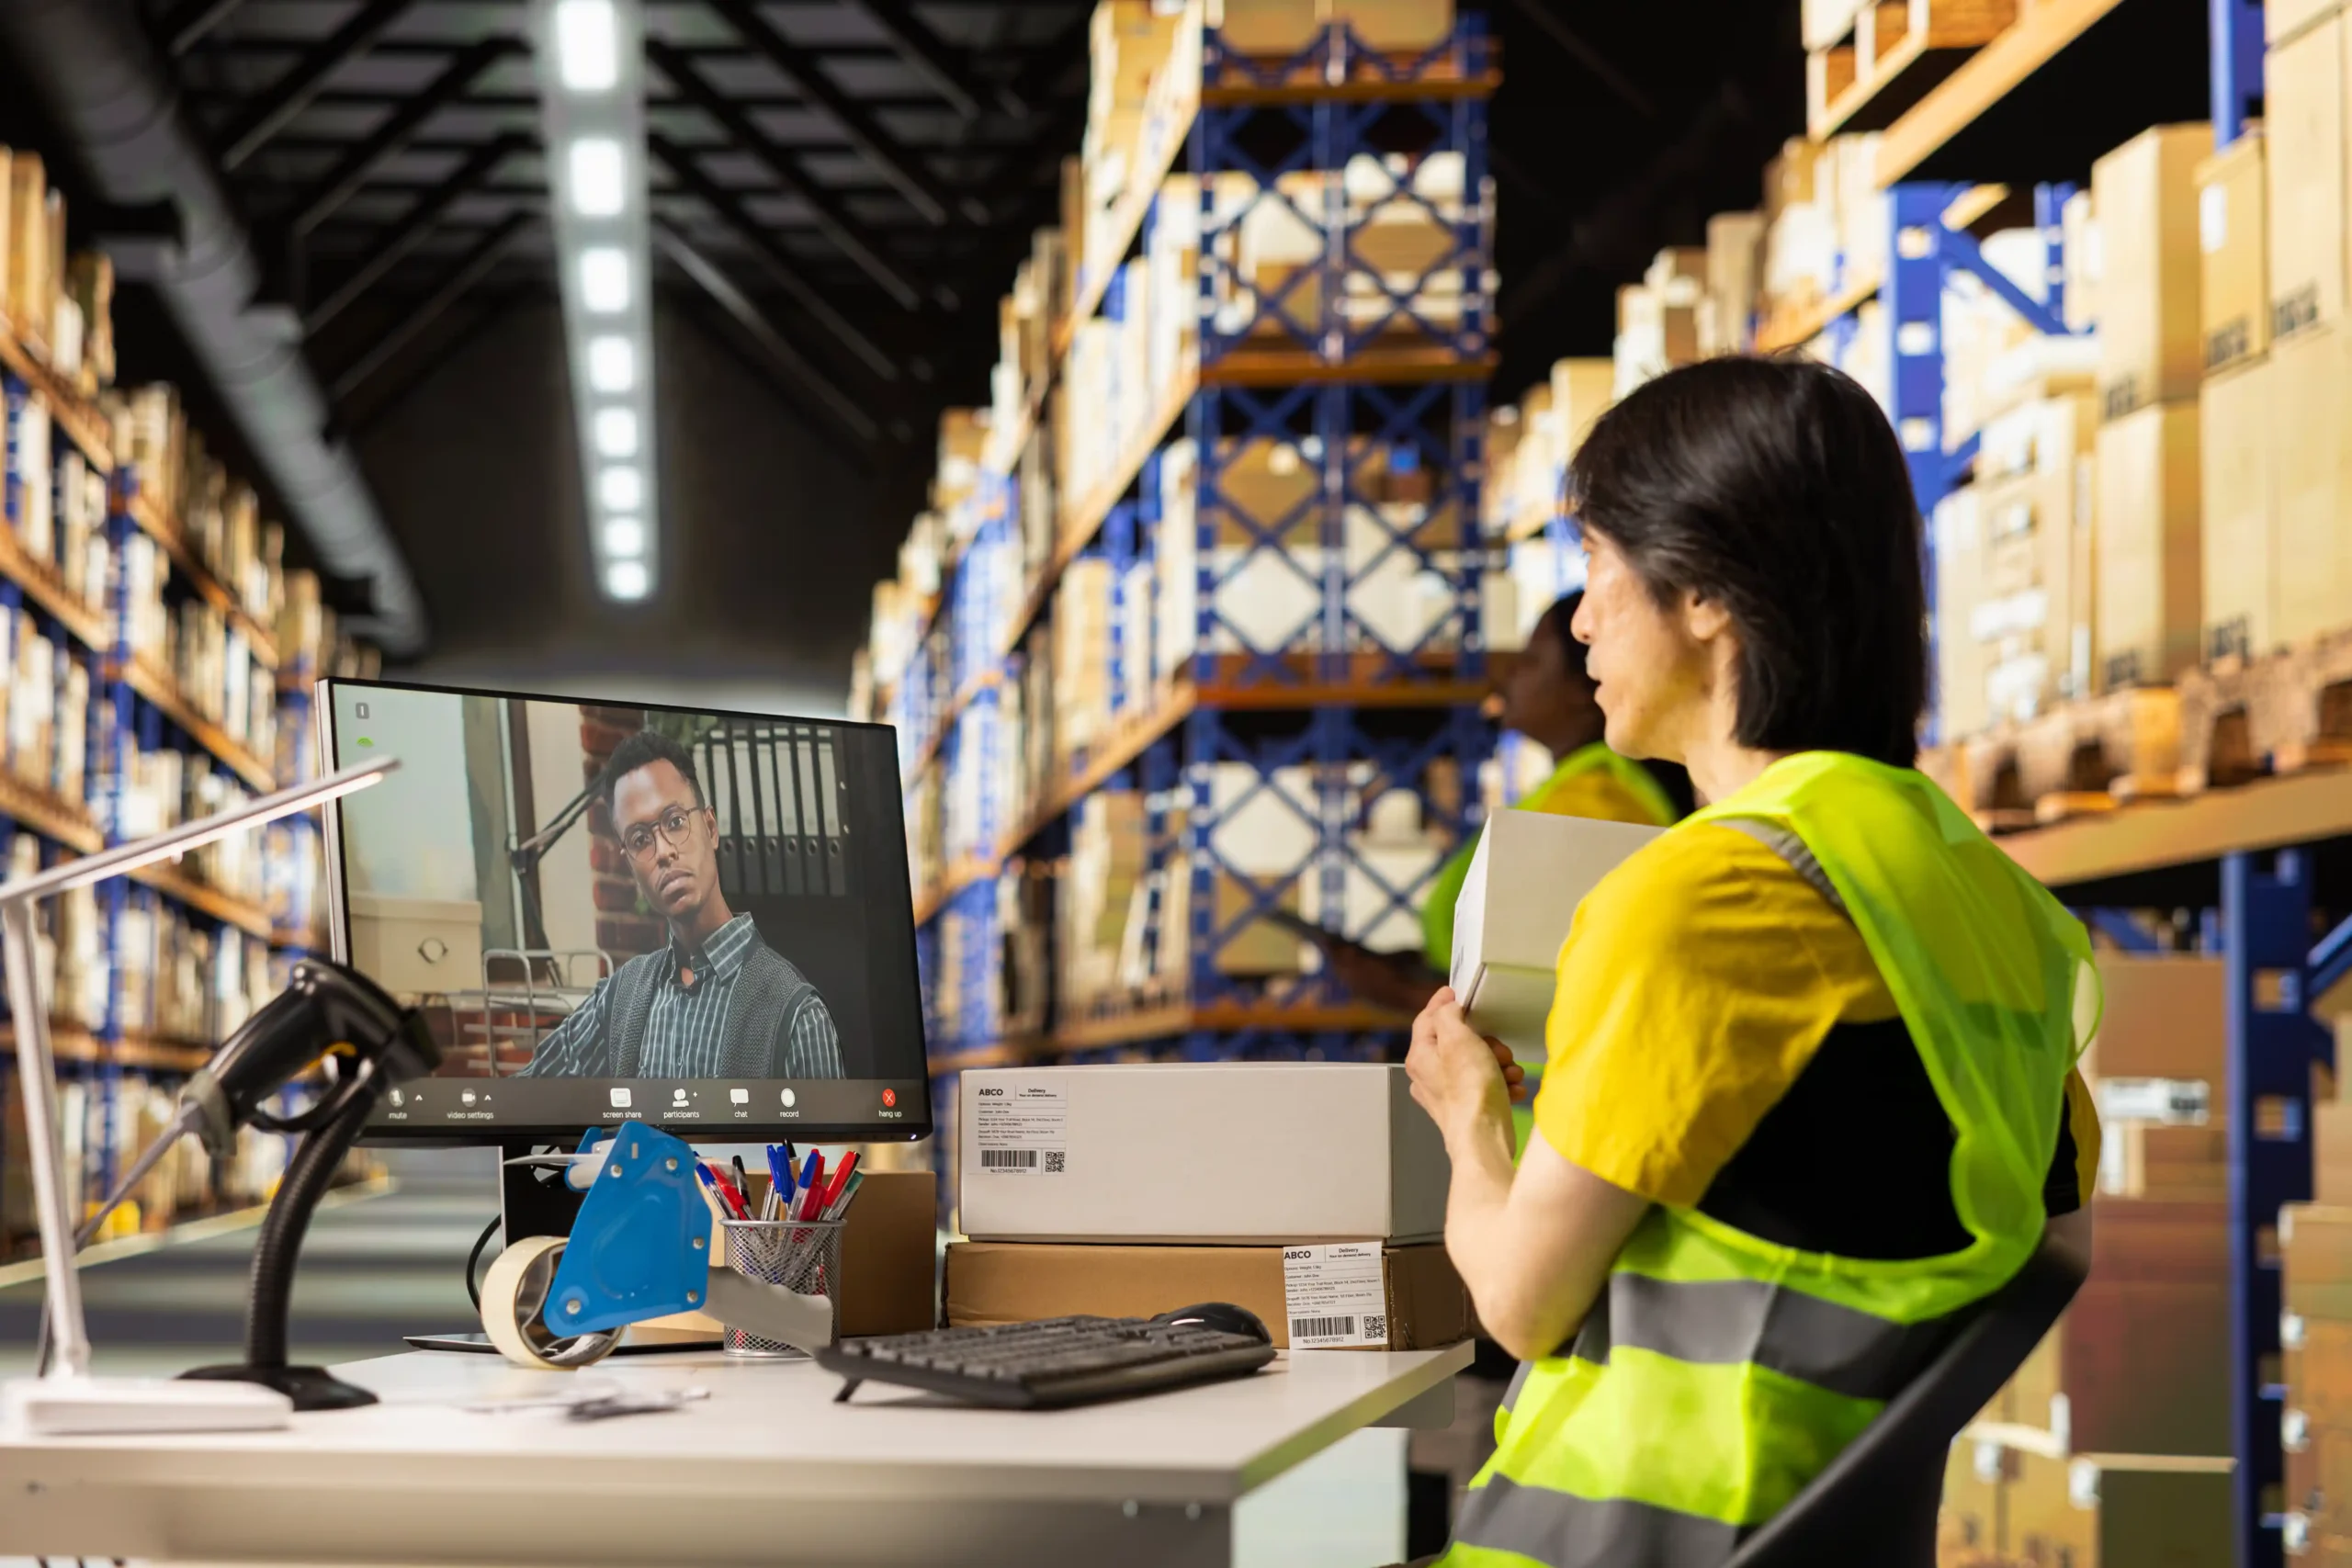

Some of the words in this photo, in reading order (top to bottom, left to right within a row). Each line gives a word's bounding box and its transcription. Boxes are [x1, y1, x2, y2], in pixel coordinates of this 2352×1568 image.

[467, 1111, 494, 1120] settings
[664, 1110, 699, 1119] participants
[879, 1110, 894, 1118] hang
[1284, 1251, 1311, 1260] ABCO
